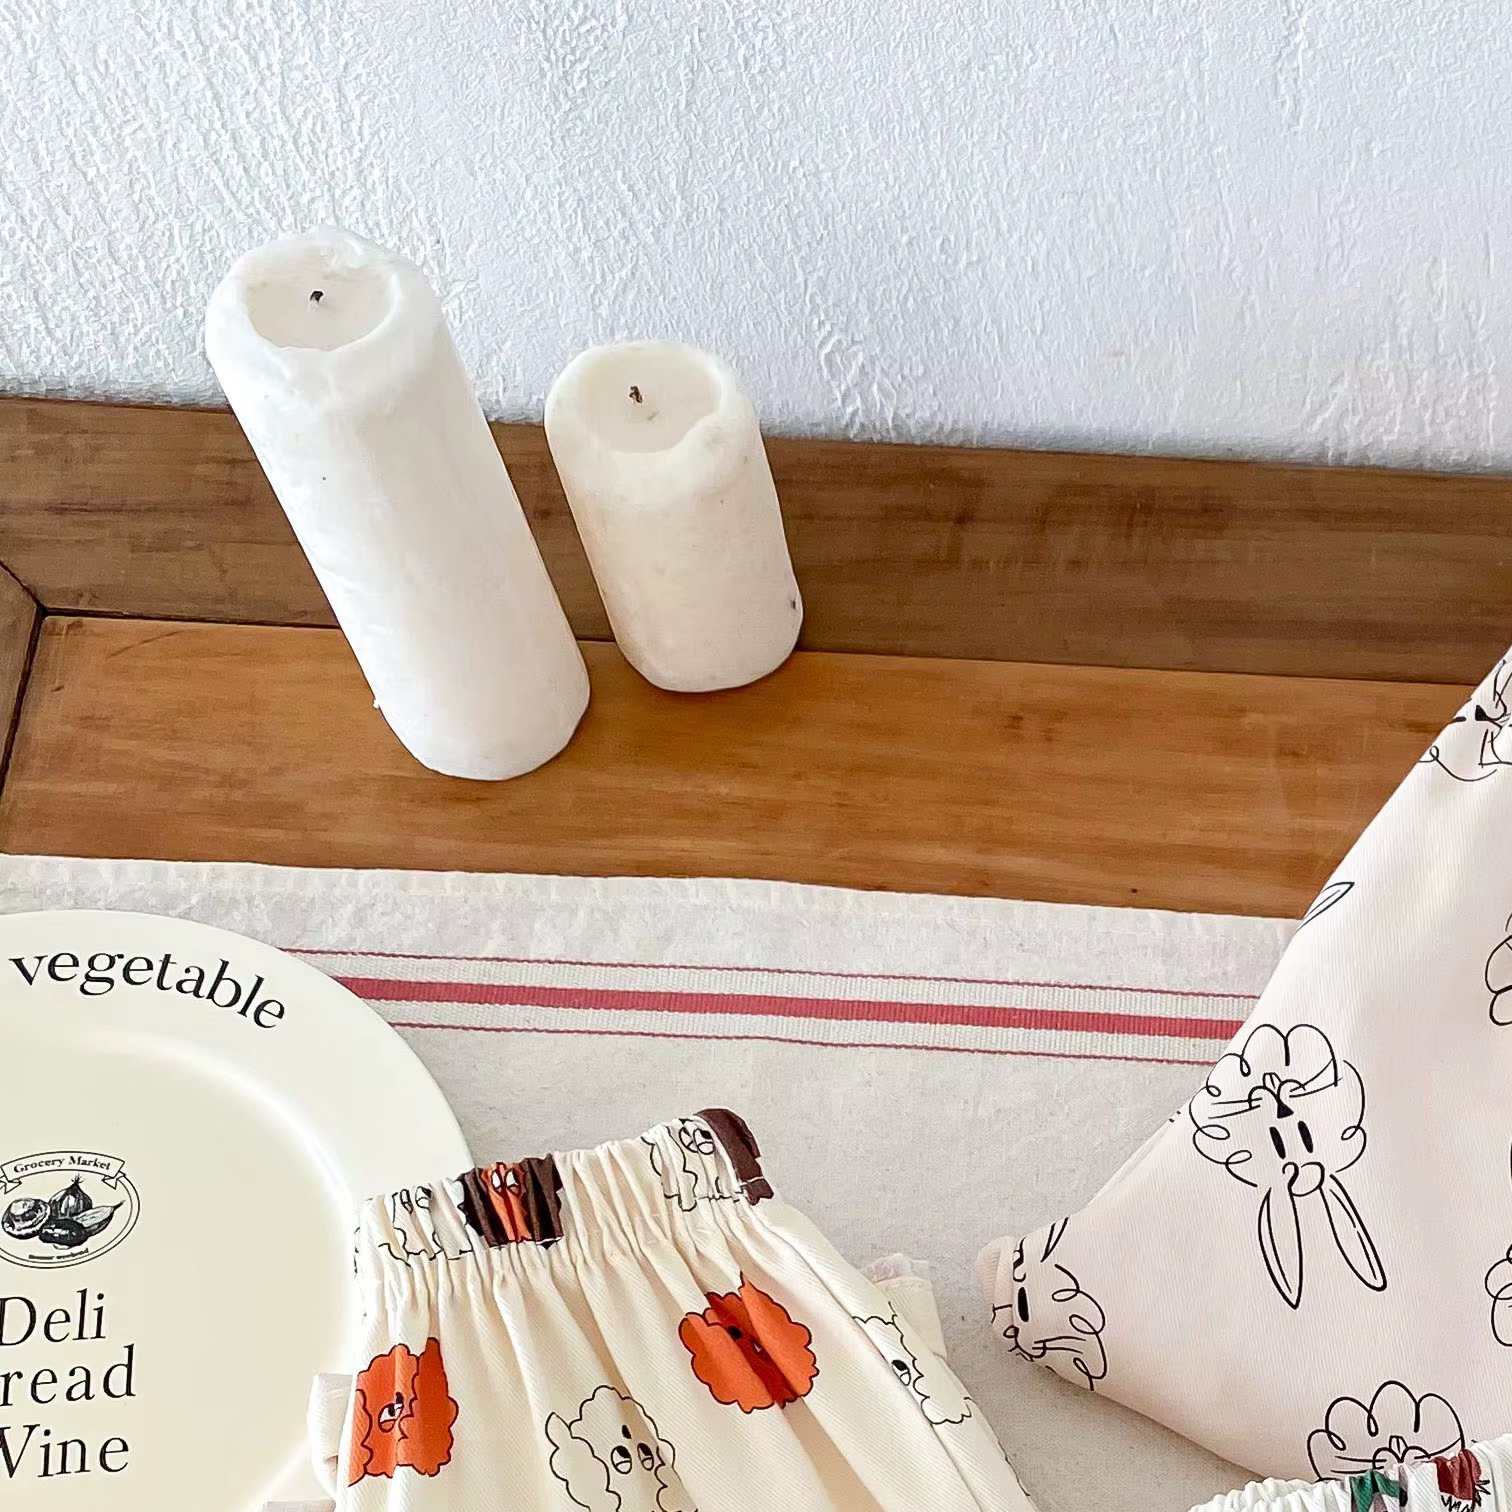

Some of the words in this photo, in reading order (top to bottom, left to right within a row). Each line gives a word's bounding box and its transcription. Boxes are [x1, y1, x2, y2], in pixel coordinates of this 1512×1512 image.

[10, 952, 285, 1029] vegetable
[13, 1158, 65, 1173] Grocery
[68, 1156, 111, 1170] Market
[0, 1288, 107, 1346] Deli
